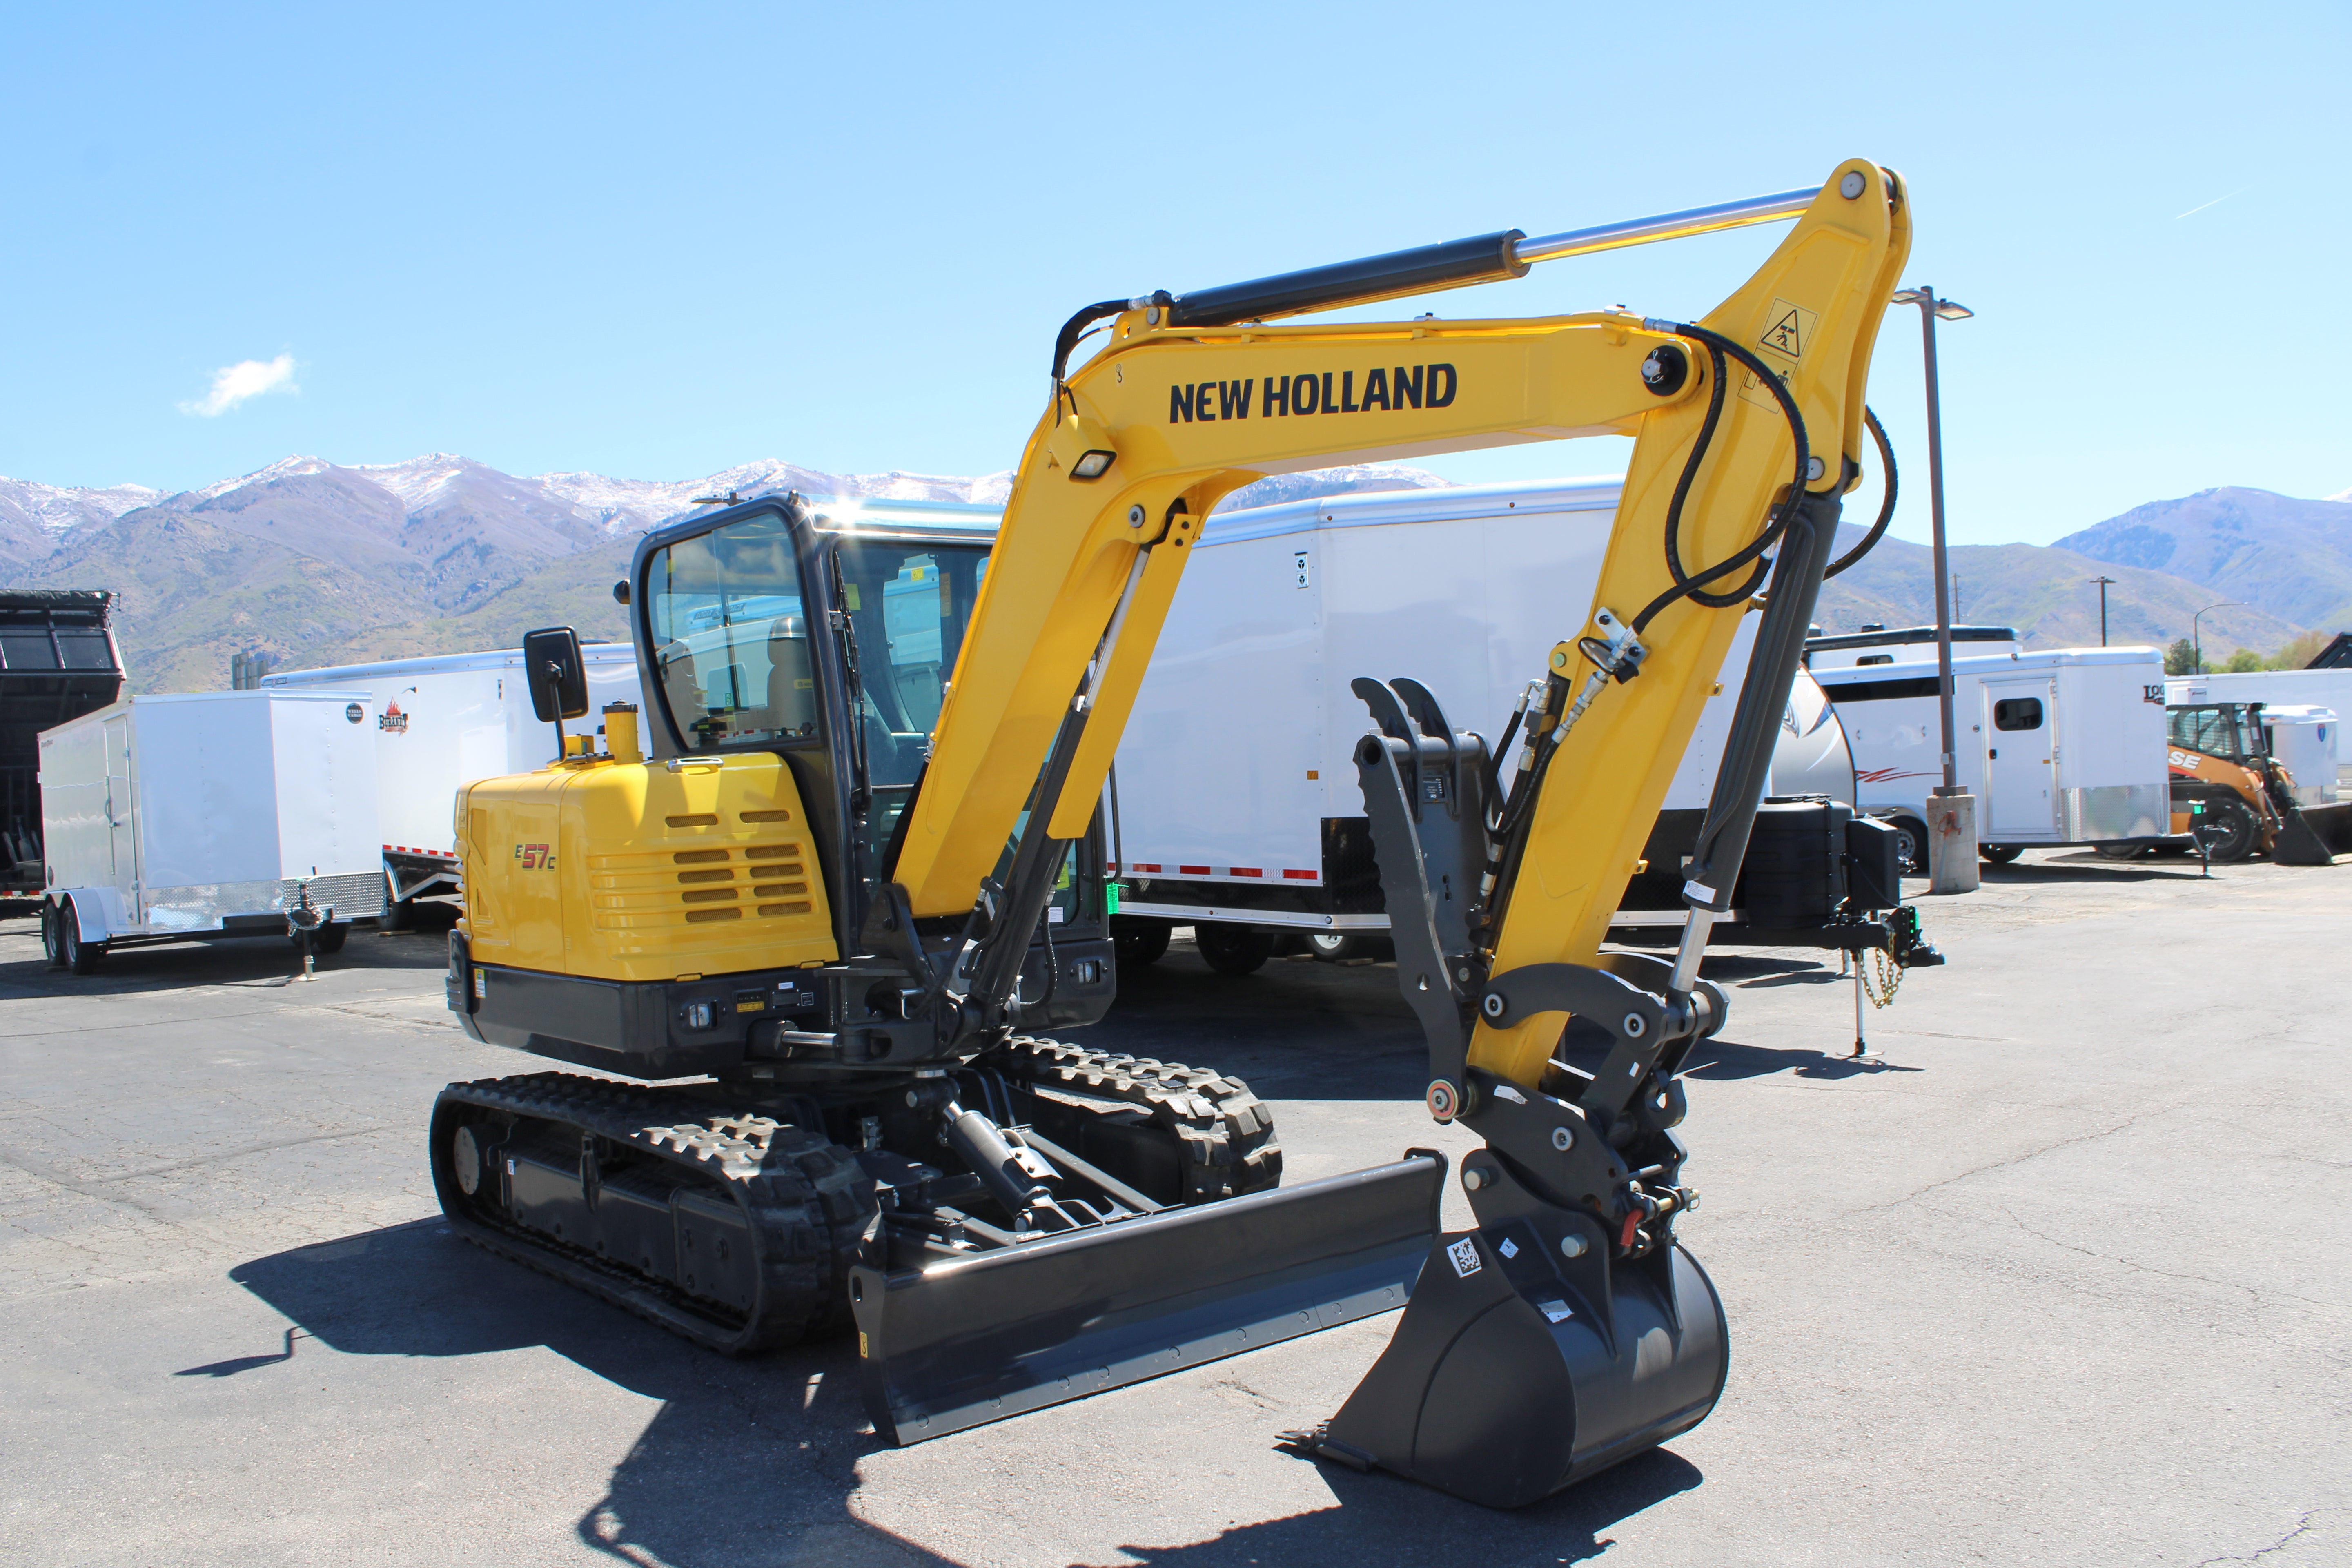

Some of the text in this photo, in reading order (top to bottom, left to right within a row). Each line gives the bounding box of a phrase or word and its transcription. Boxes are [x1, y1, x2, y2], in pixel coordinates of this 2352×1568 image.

[1170, 363, 1457, 424] NEW HOLLAND
[2167, 749, 2202, 770] SE
